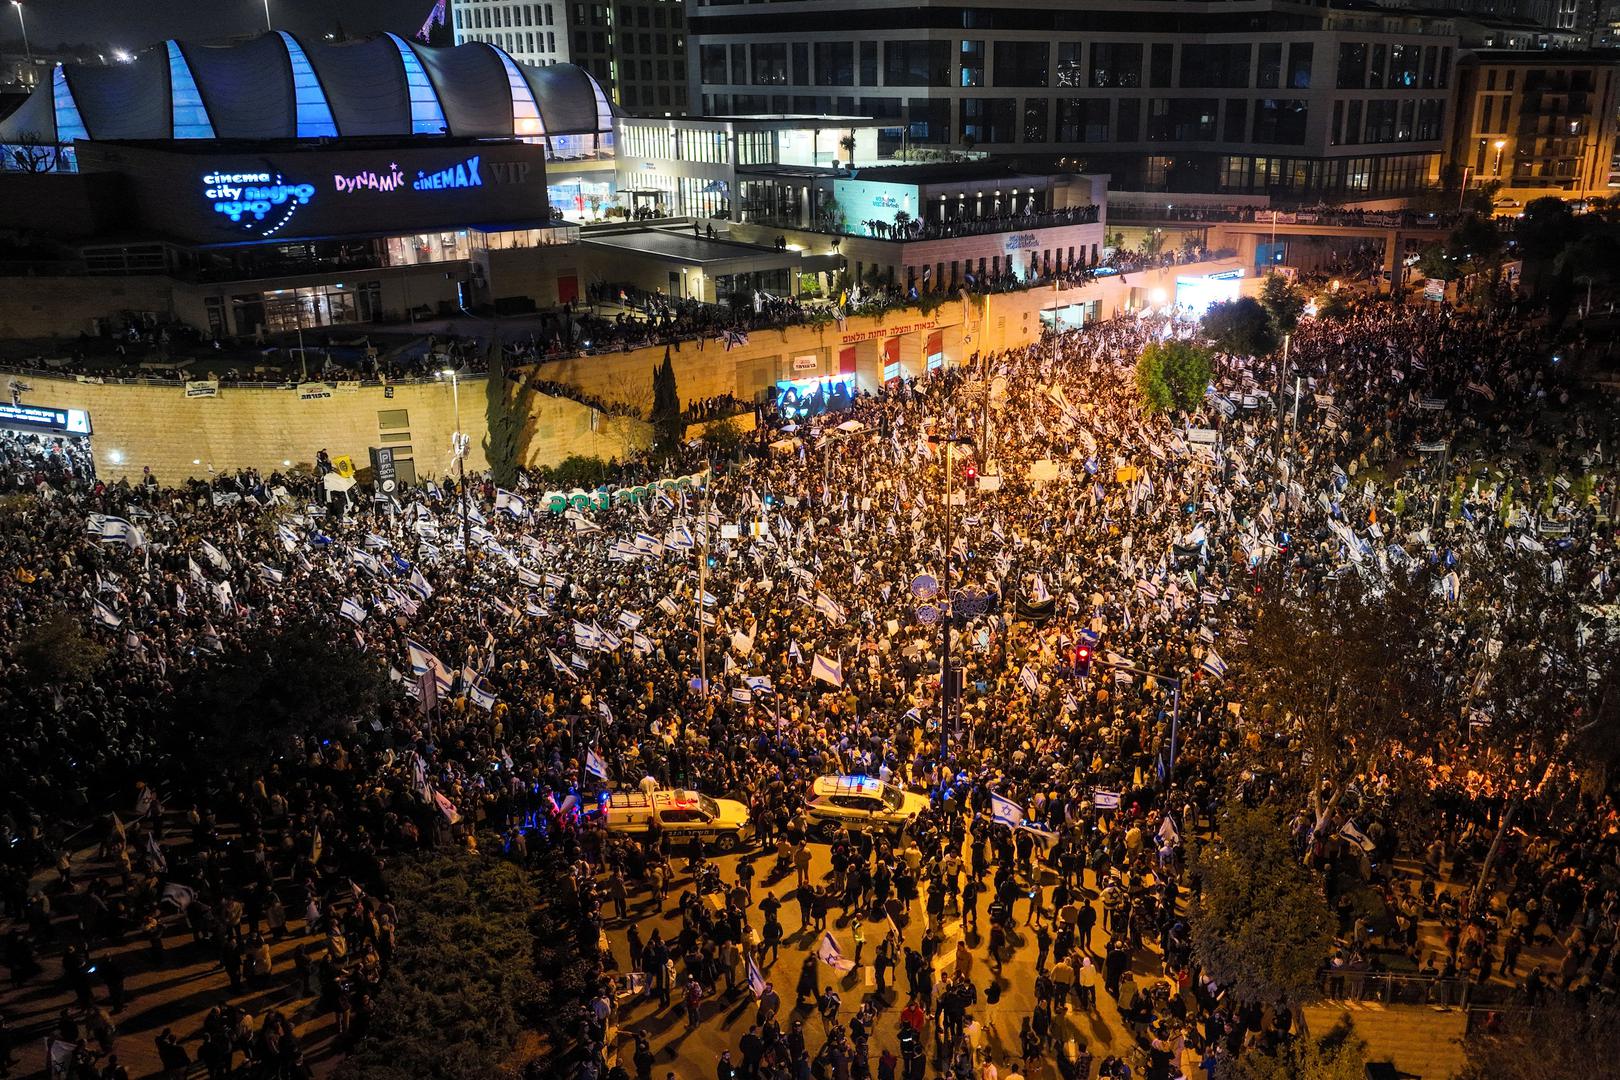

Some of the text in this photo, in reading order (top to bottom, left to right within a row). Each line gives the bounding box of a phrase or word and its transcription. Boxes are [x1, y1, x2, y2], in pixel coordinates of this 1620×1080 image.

[203, 171, 270, 184] cinema
[489, 162, 530, 185] VIP
[205, 184, 243, 200] city
[842, 321, 936, 343] כבאות והצלה תחנת הלאום
